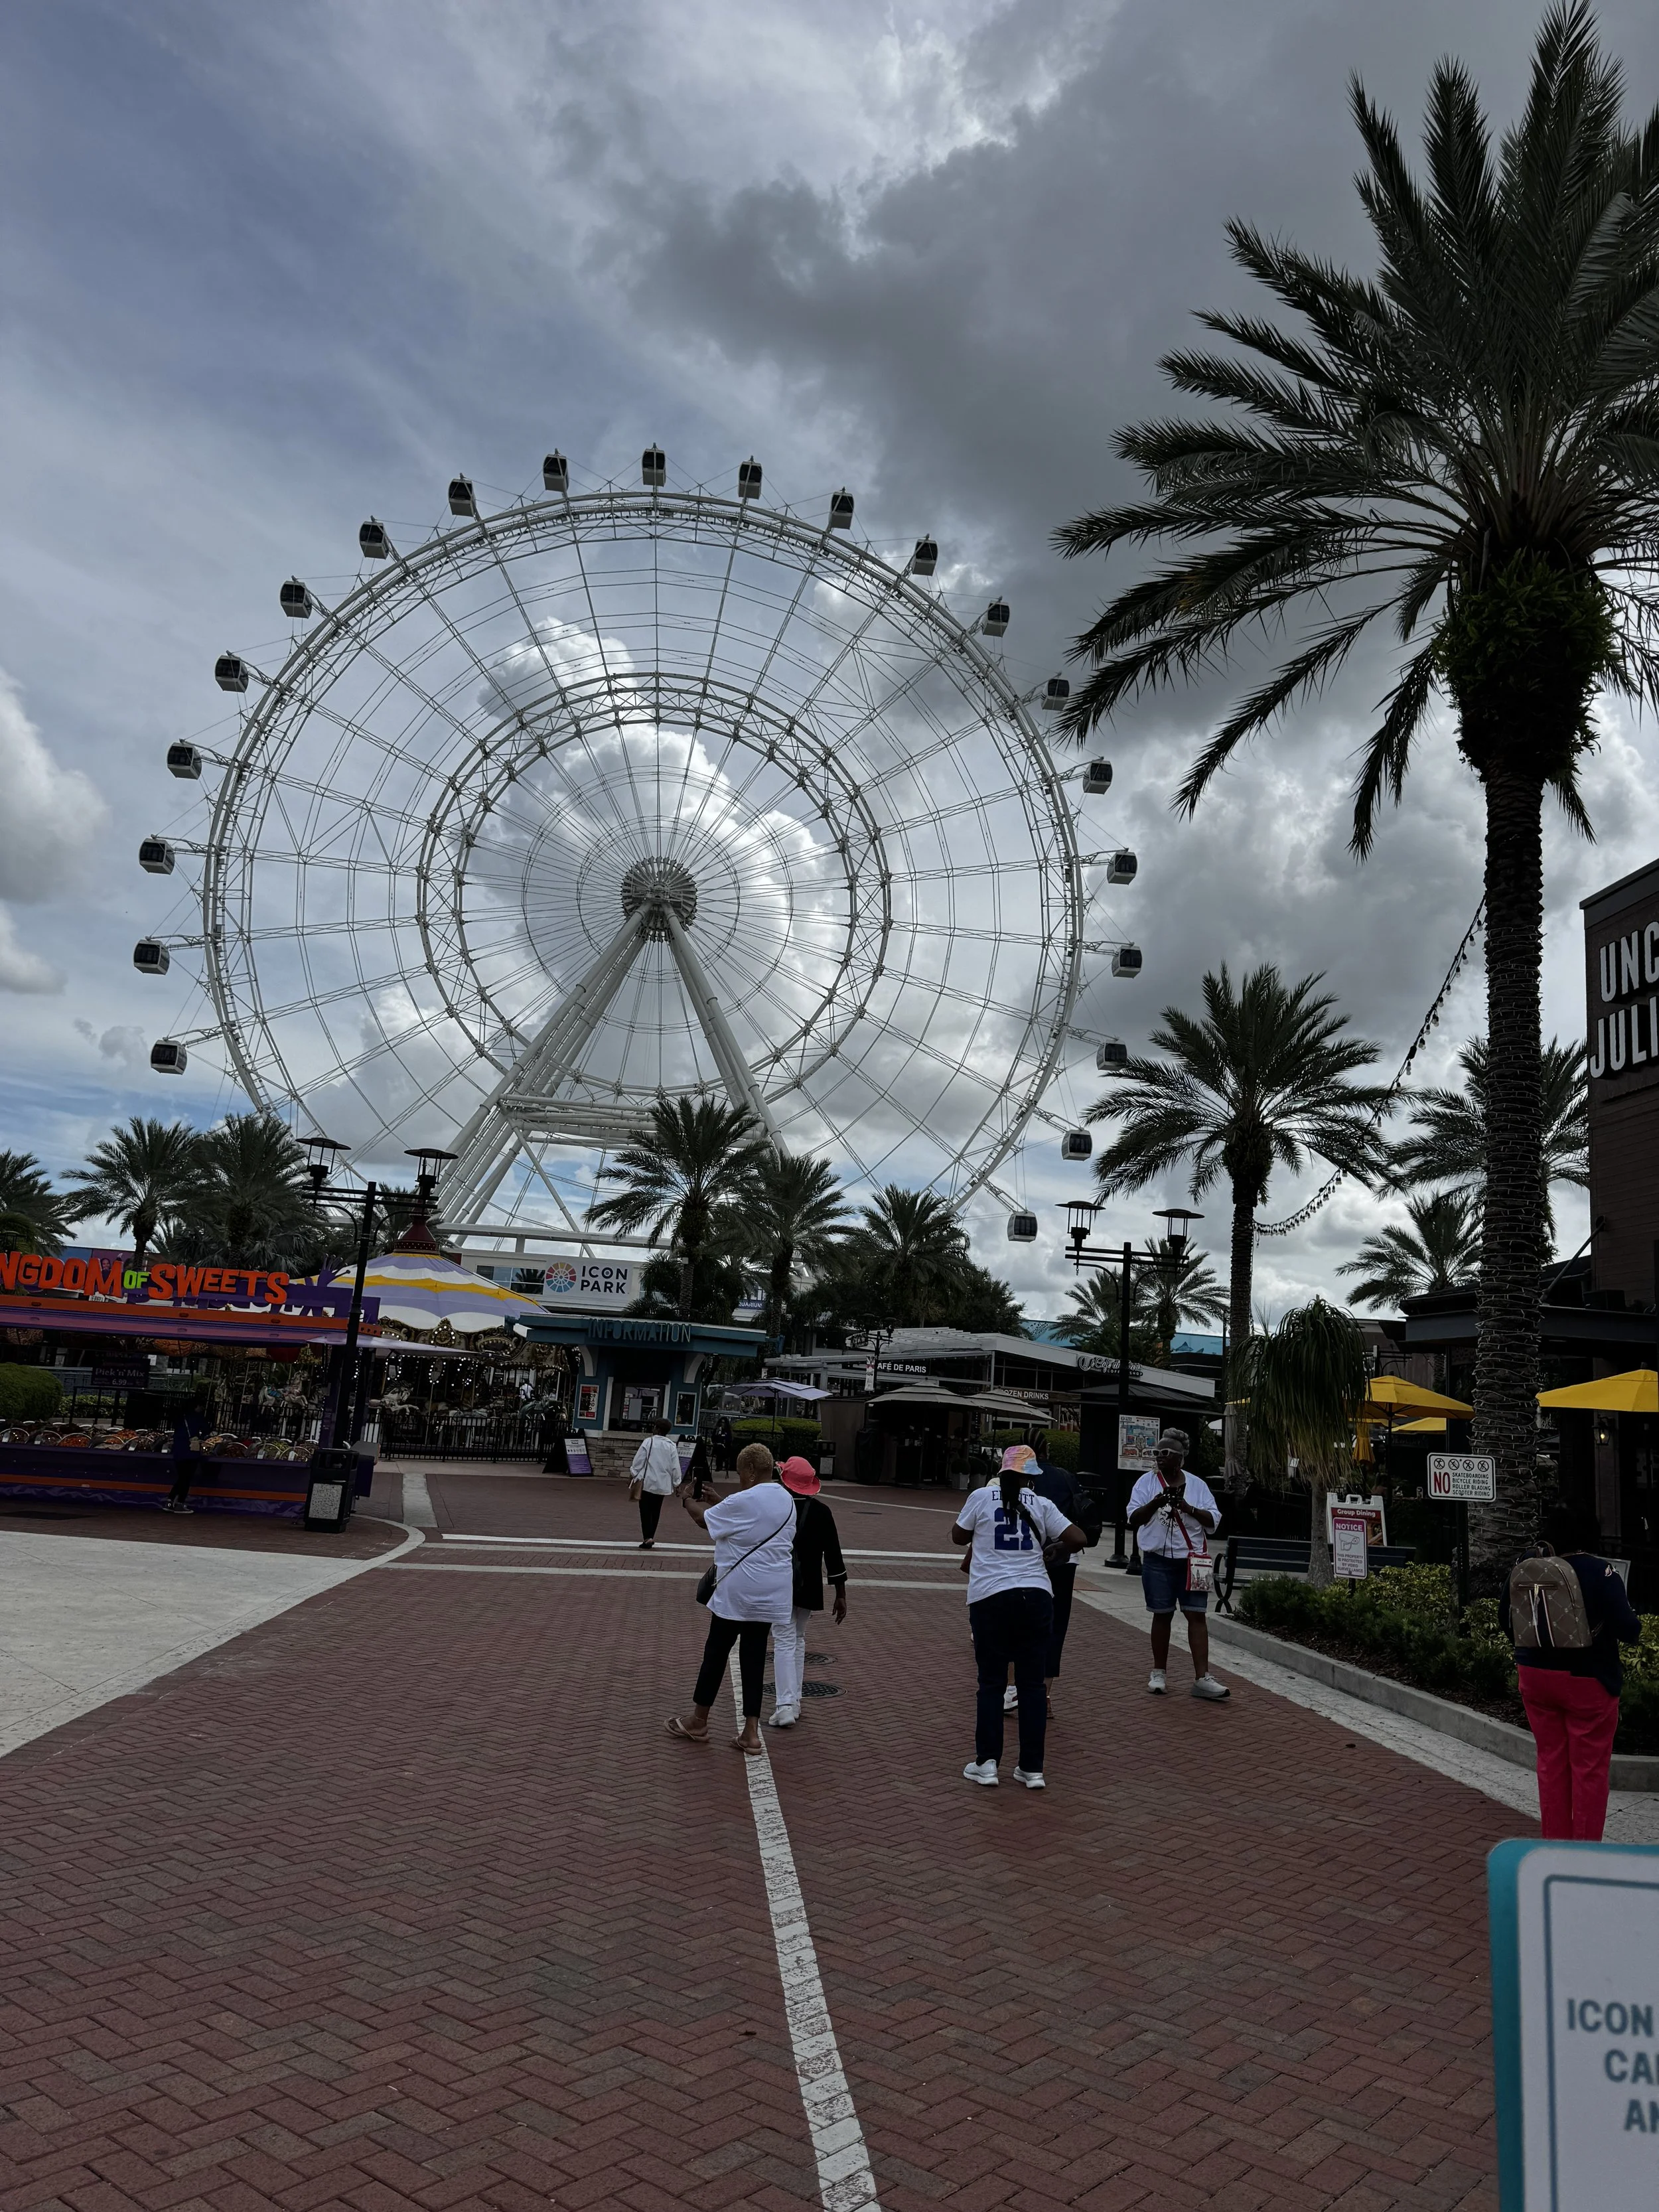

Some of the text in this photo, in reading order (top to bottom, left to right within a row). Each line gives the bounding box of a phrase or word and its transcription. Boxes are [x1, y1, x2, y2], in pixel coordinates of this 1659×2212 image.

[123, 1269, 149, 1290] OF
[148, 1263, 290, 1305] SWEETS
[581, 1266, 628, 1280] ICON
[581, 1280, 626, 1294] PARK
[588, 1319, 691, 1344] INFORMATION
[877, 1361, 892, 1370] AFÉ
[905, 1364, 927, 1373] PARIS
[1003, 1389, 1049, 1400] OZEN DRINKS
[1433, 1471, 1451, 1494] NO
[994, 1507, 1033, 1550] 21
[1336, 1522, 1363, 1531] NOTICE
[1567, 1998, 1654, 2037] ICON
[1604, 2049, 1659, 2085] CA
